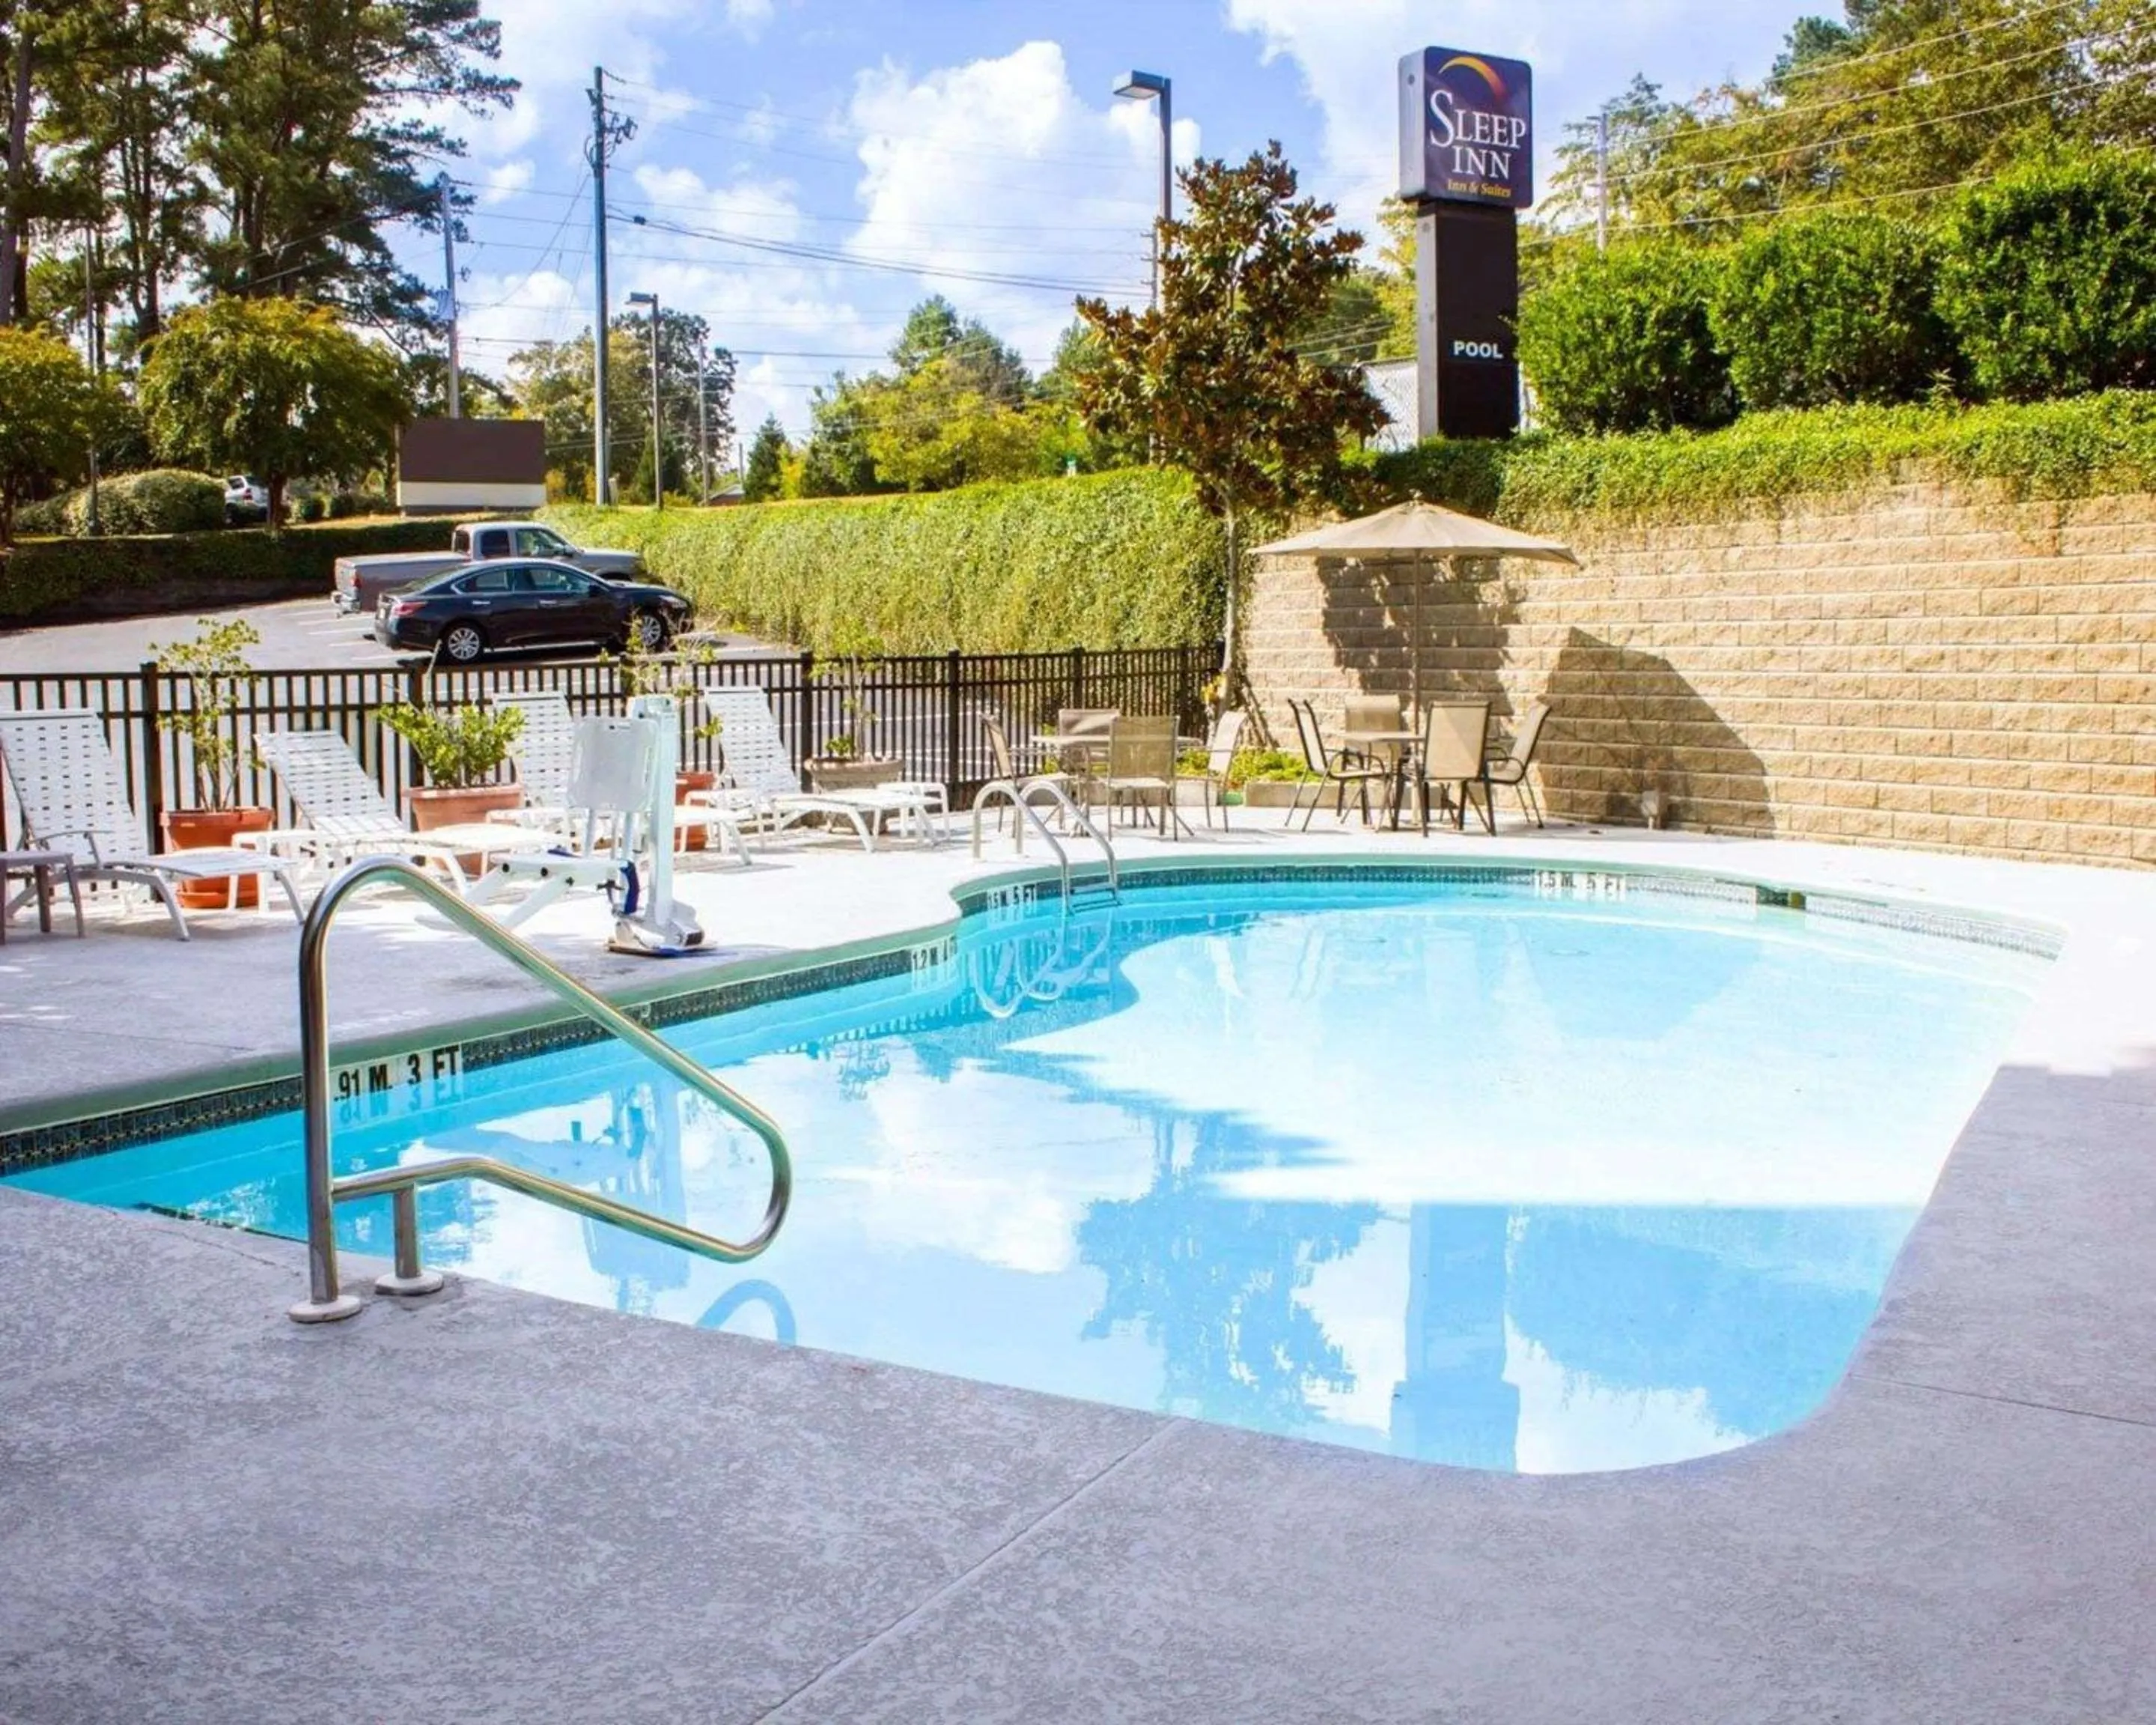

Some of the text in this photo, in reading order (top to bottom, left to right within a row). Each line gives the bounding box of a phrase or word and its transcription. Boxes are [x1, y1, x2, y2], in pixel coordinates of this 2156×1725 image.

[1430, 89, 1526, 149] SLEEP
[1452, 145, 1511, 180] INN
[1447, 179, 1511, 198] Inn & Suites
[1453, 340, 1504, 359] POOL
[1586, 871, 1596, 889] 5
[1604, 872, 1624, 891] FT
[333, 1044, 460, 1102] .91 M. 3 FT
